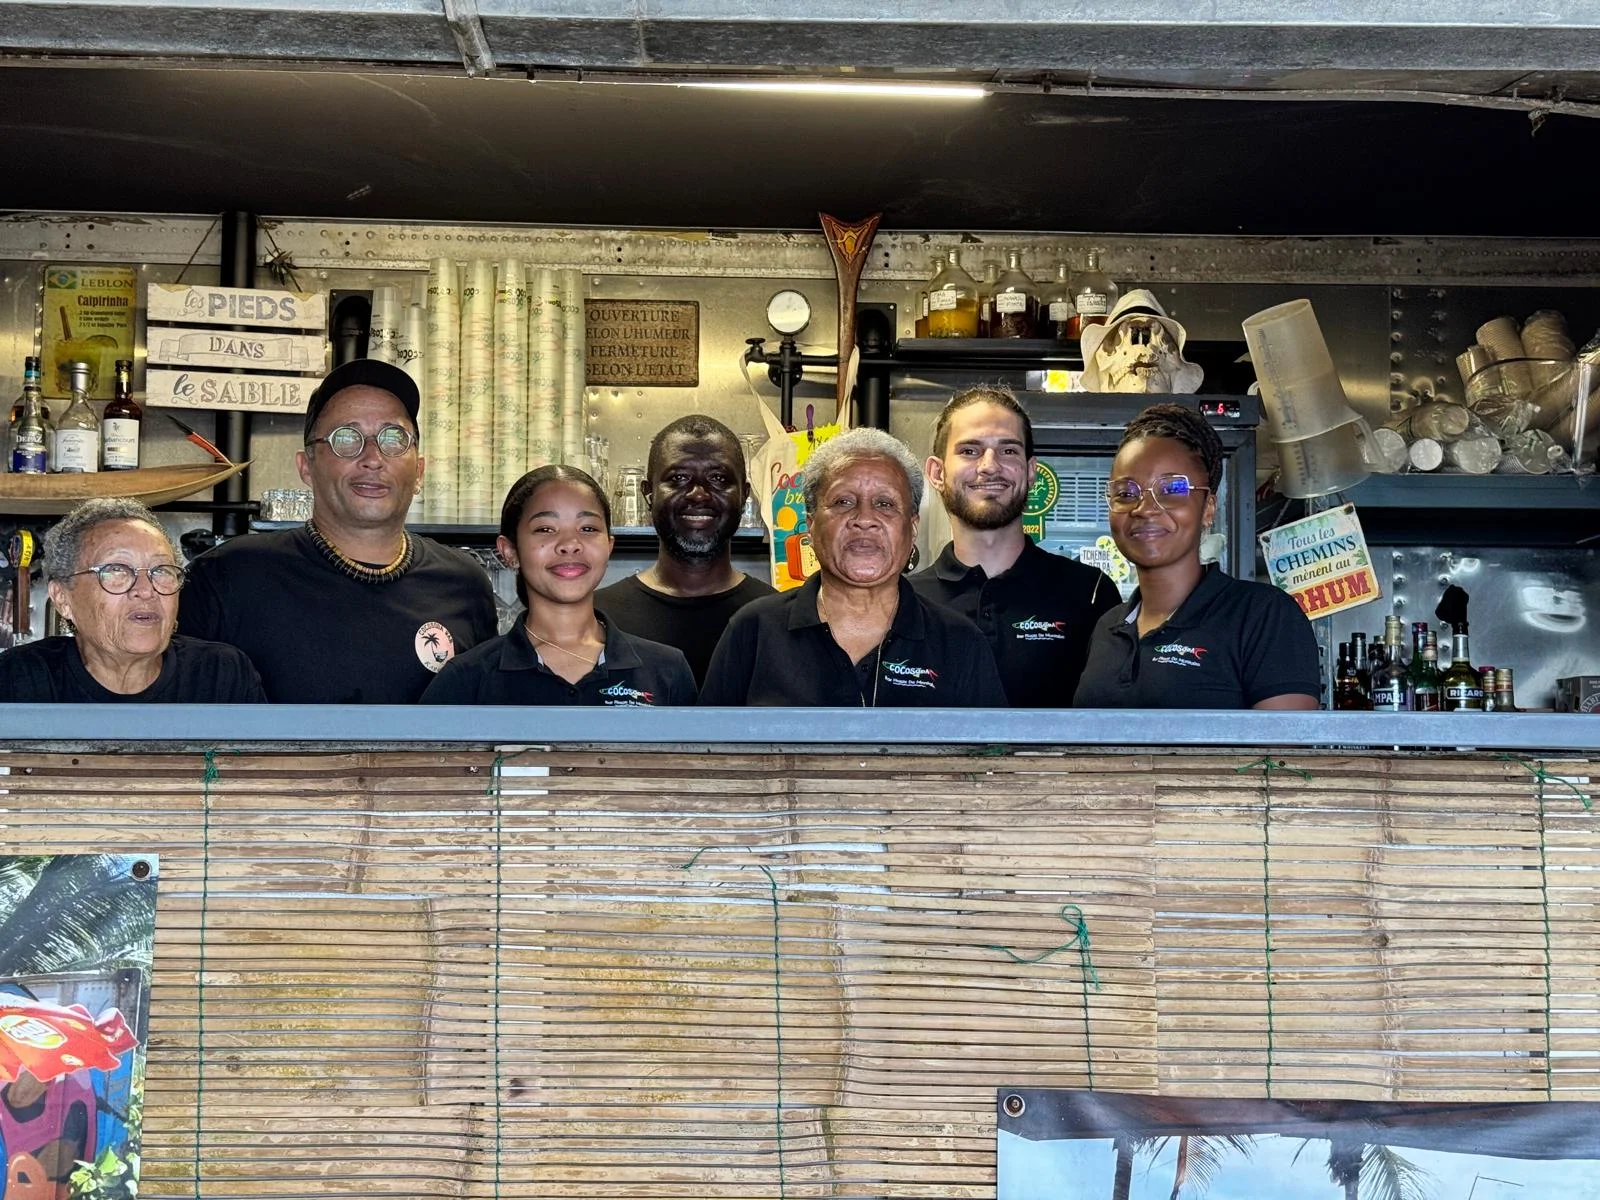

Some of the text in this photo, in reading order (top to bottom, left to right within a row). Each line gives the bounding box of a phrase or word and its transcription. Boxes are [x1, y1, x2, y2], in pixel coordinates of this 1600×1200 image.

[81, 278, 134, 288] LEBLON
[77, 295, 129, 307] Caipirinha
[184, 289, 297, 321] les PIEDS
[590, 309, 680, 322] OUVERTURE
[586, 327, 690, 340] ELON L'HUMEUR
[209, 336, 265, 358] DANS
[591, 345, 680, 358] FERMETURE
[173, 373, 301, 407] le SABLE
[1023, 525, 1040, 534] 2022
[1287, 527, 1336, 550] Tous les
[1275, 535, 1356, 574] CHEMINS
[1292, 558, 1351, 585] mènent au
[1292, 571, 1372, 614] RHUM
[1374, 692, 1404, 704] MPARI
[1449, 689, 1484, 697] RICARD
